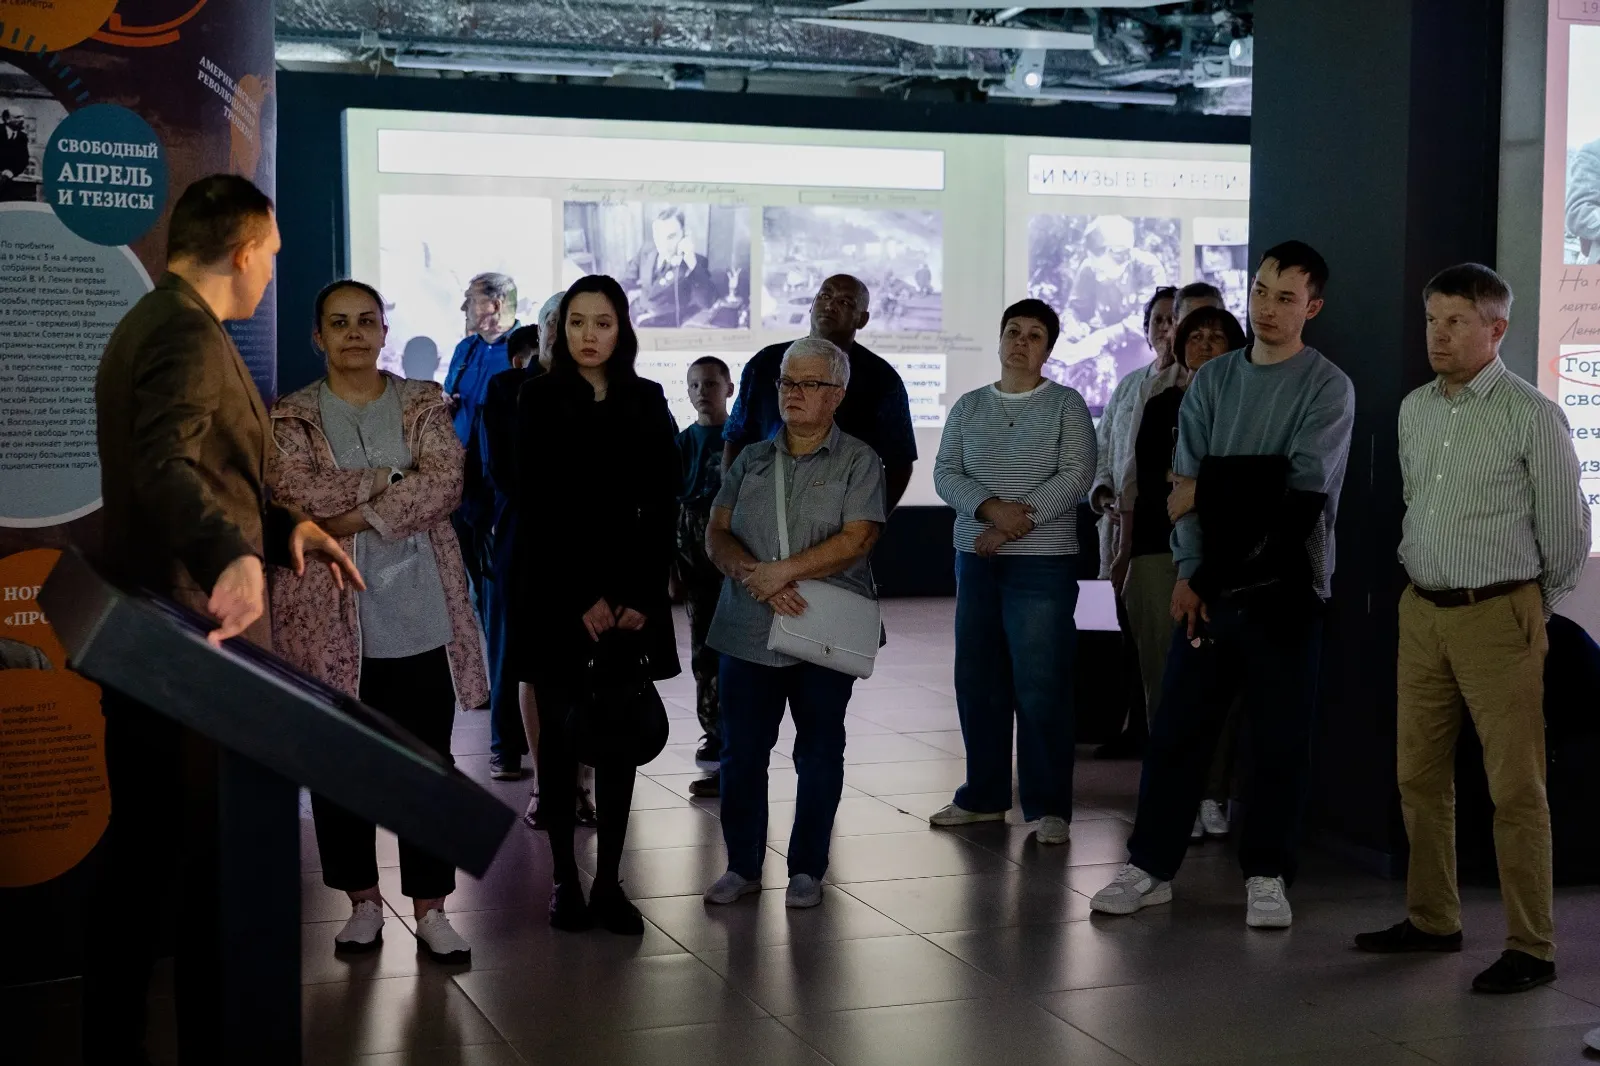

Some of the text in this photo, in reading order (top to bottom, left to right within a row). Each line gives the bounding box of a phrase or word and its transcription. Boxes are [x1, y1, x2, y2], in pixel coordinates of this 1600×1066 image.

[57, 138, 158, 159] СВОБОДНЫЙ
[57, 162, 153, 187] АПРЕЛЬ
[1062, 169, 1119, 187] МУЗЫ
[58, 189, 154, 210] И ТЕЗИСЫ
[48, 275, 73, 283] Ленин
[75, 277, 106, 285] впервые
[86, 299, 129, 308] буржуазной
[42, 330, 74, 338] Советам
[29, 396, 56, 404] России
[62, 407, 87, 415] сейчас
[36, 702, 57, 712] 1917
